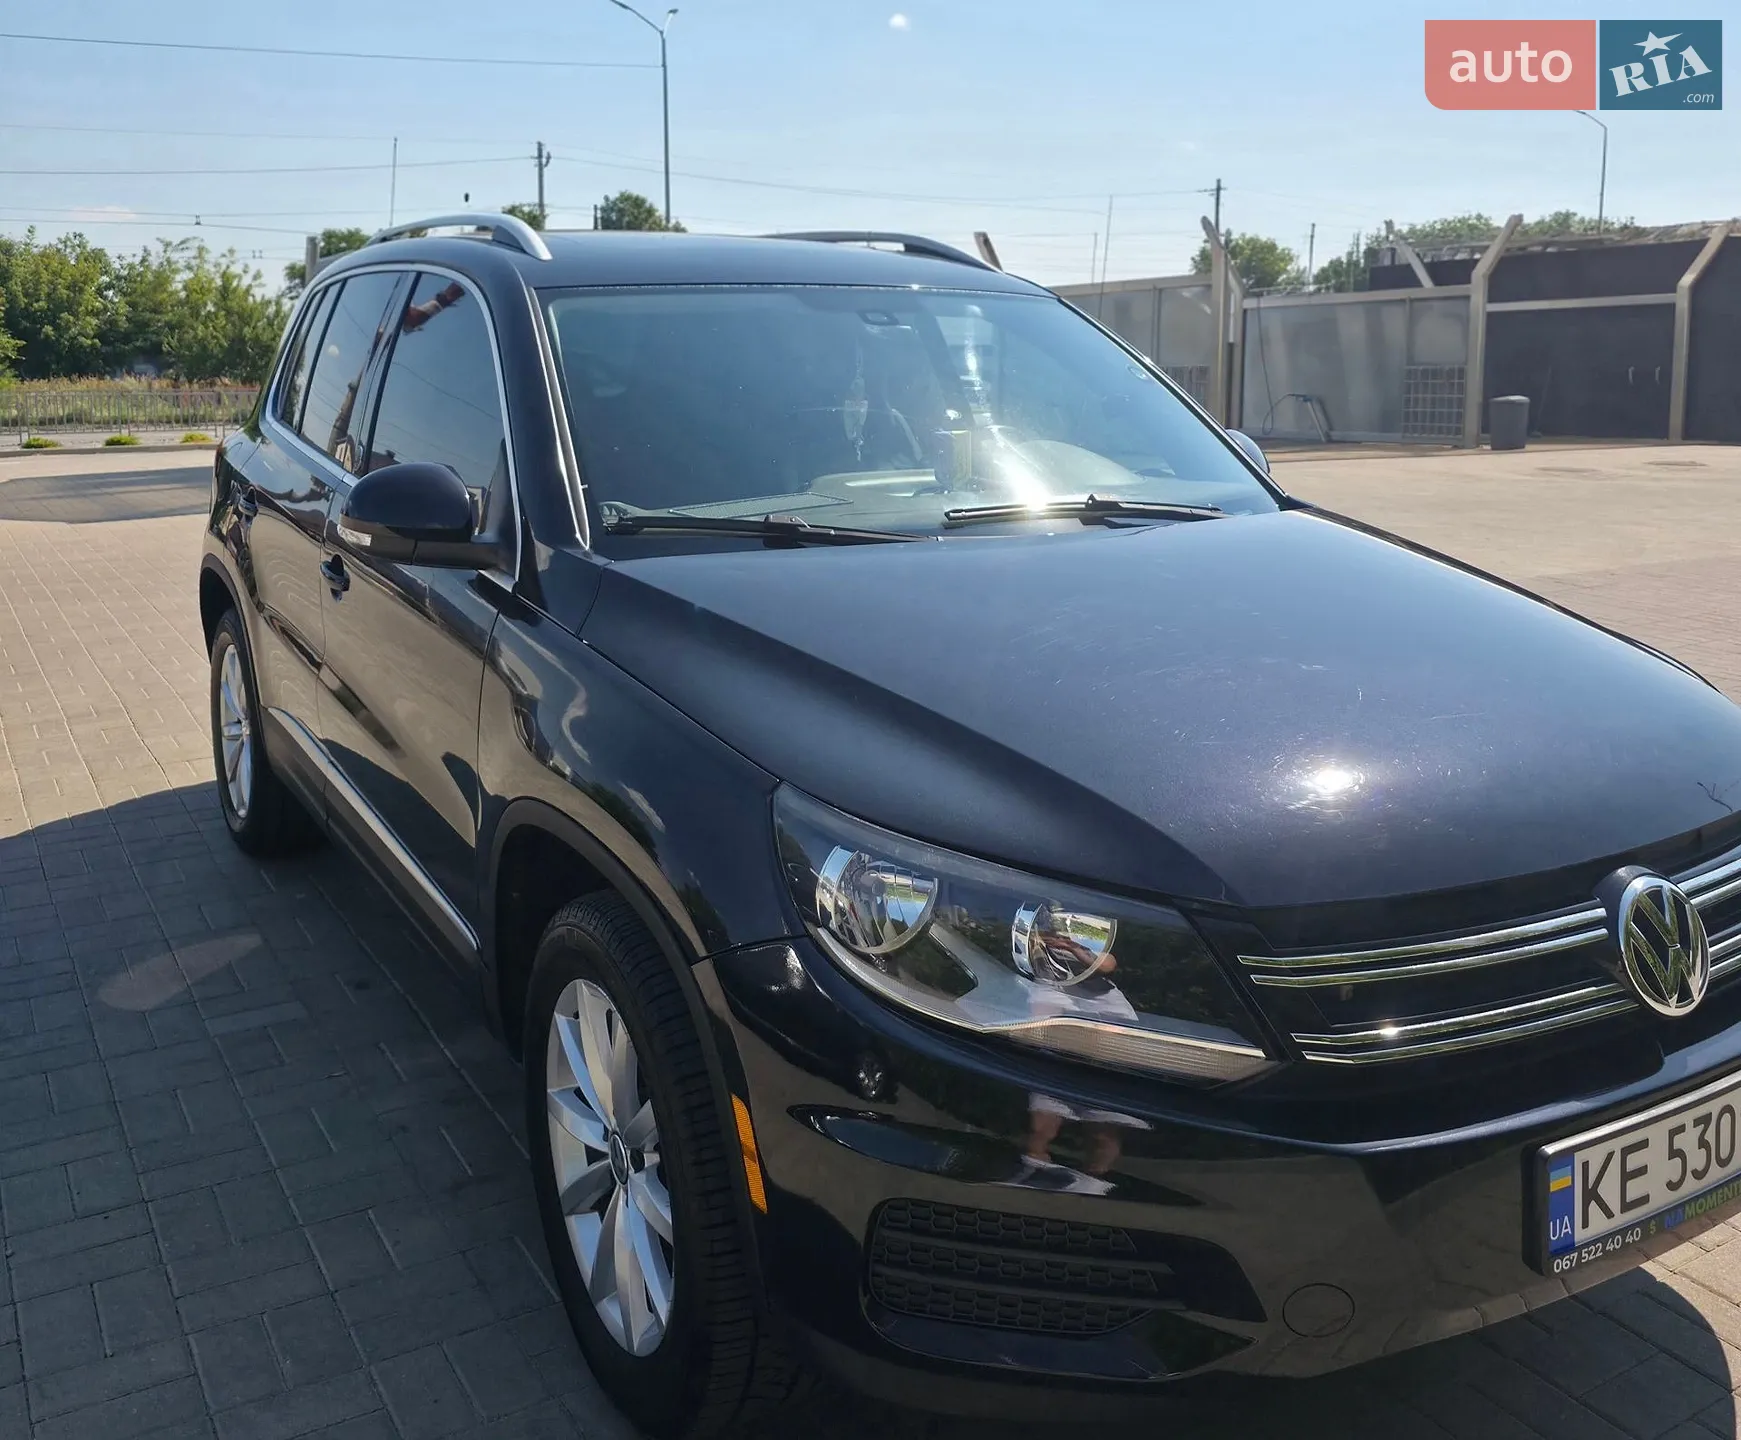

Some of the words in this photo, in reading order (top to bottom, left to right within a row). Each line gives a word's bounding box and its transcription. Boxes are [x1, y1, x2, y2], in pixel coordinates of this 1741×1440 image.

[1581, 1138, 1650, 1230] KE
[1665, 1103, 1737, 1192] 530
[1549, 1215, 1572, 1241] UA
[1553, 1252, 1578, 1273] 067
[1581, 1243, 1603, 1263] 522
[1605, 1235, 1622, 1252] 40
[1625, 1227, 1641, 1244] 40
